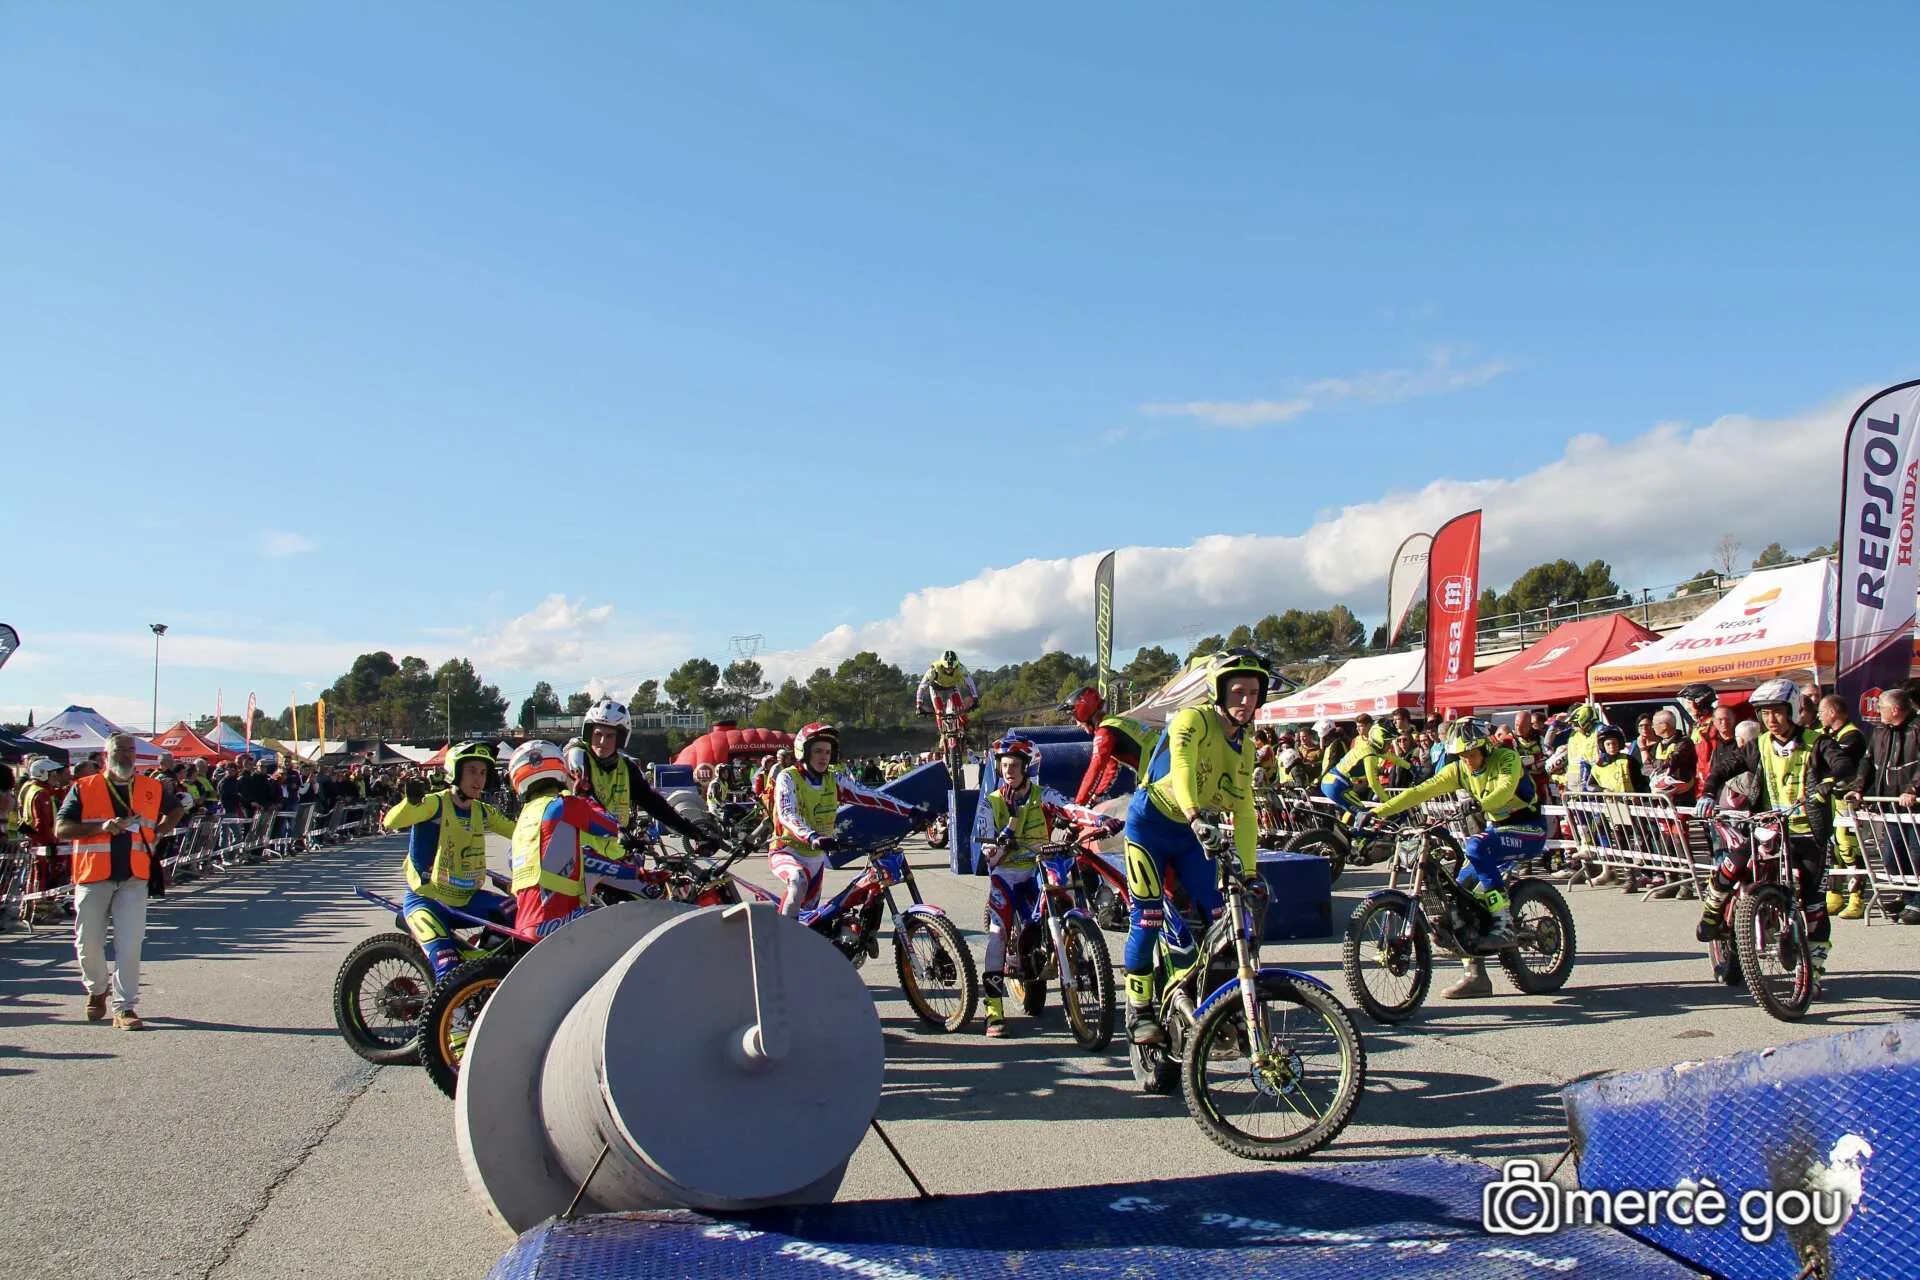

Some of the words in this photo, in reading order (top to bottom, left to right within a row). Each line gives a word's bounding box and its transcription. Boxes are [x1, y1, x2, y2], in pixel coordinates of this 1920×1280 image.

[1857, 413, 1900, 611] REPSOL
[1898, 458, 1919, 566] HONDA
[1667, 628, 1768, 651] HONDA
[1697, 661, 1735, 674] Repsol
[1737, 657, 1775, 669] Honda
[1777, 651, 1811, 665] Team
[1500, 835, 1523, 849] KENNY
[585, 857, 621, 875] OTS
